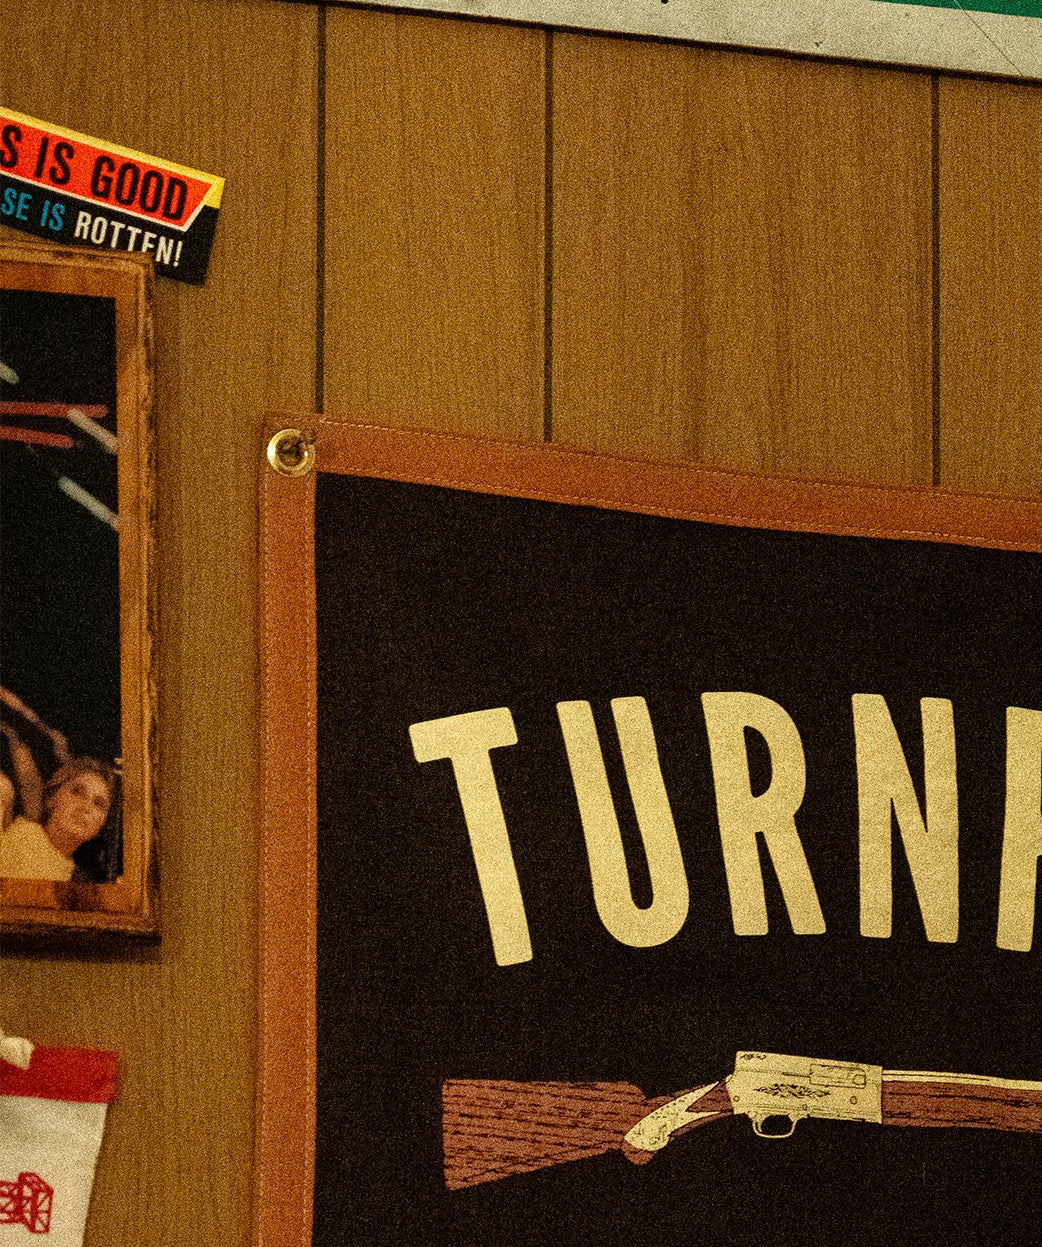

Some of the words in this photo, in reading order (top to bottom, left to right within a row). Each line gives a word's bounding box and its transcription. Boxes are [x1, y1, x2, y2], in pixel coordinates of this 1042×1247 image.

[34, 137, 74, 185] IS
[90, 155, 188, 220] GOOD
[40, 200, 65, 231] IS
[74, 210, 183, 267] ROTTEN!
